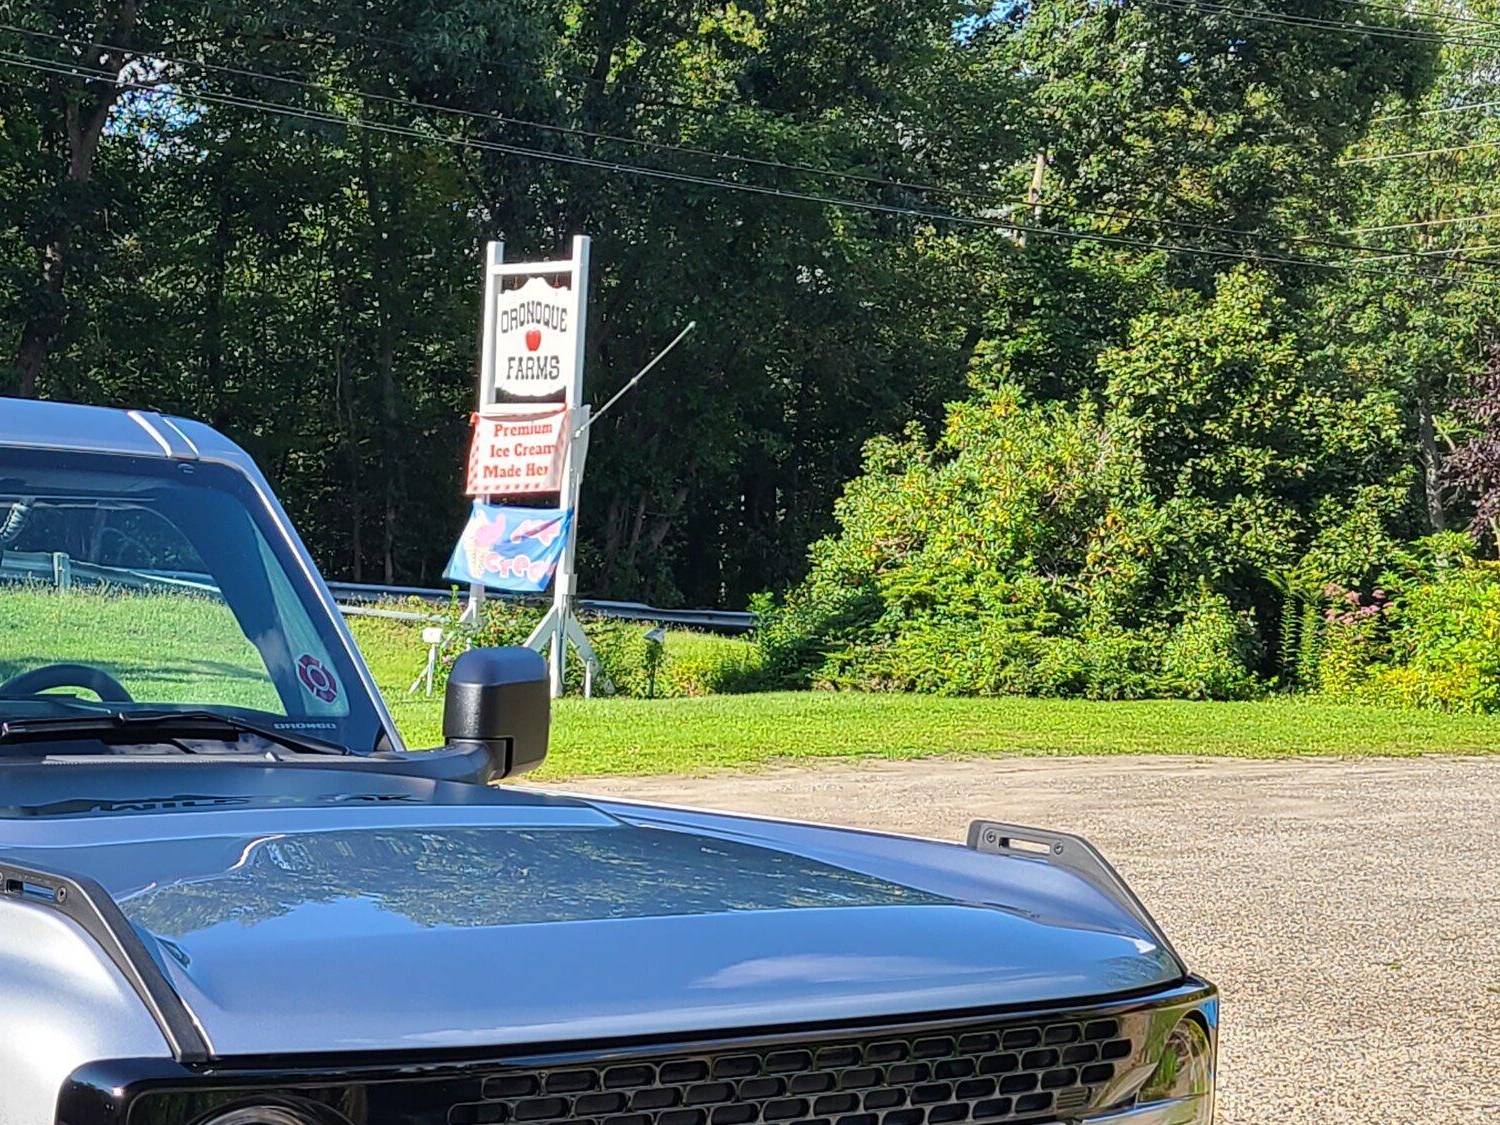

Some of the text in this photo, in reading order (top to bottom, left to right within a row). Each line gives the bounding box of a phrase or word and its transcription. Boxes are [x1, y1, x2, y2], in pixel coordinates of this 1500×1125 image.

[501, 300, 567, 333] ORONOQUE
[507, 355, 560, 380] FARMS
[494, 424, 552, 437] Premium
[490, 444, 510, 457] Ice
[483, 462, 548, 478] Made Her
